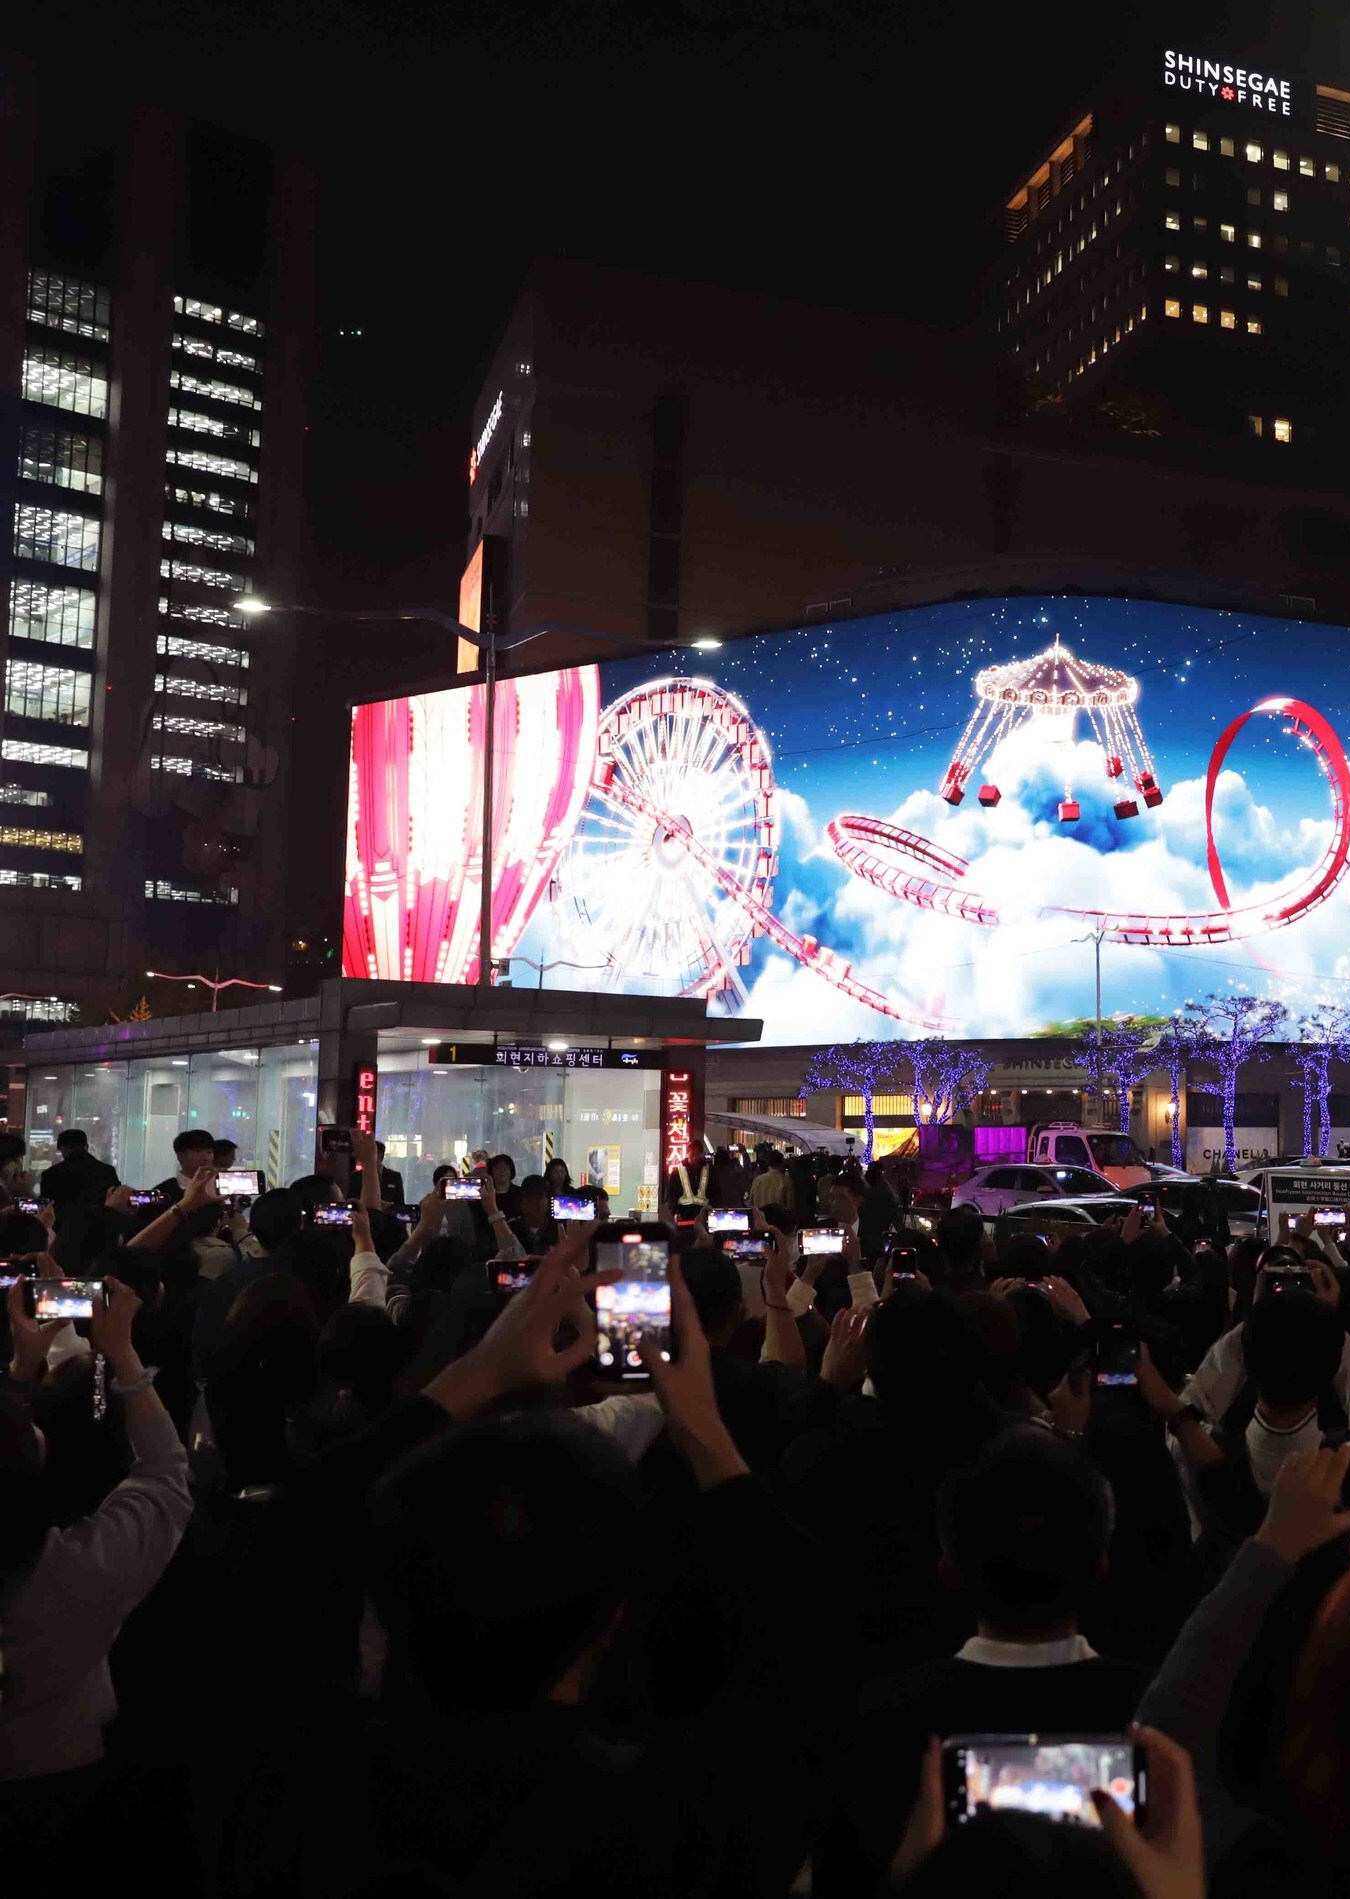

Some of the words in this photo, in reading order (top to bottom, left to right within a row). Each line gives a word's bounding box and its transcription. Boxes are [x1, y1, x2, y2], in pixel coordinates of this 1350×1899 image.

[1164, 50, 1291, 99] SHINSEGAE
[1164, 71, 1220, 97] DUTY
[1237, 89, 1291, 116] FREE
[449, 1045, 458, 1062] 1
[495, 1051, 603, 1067] 회현지하쇼핑센터
[1309, 1181, 1331, 1190] 사거리
